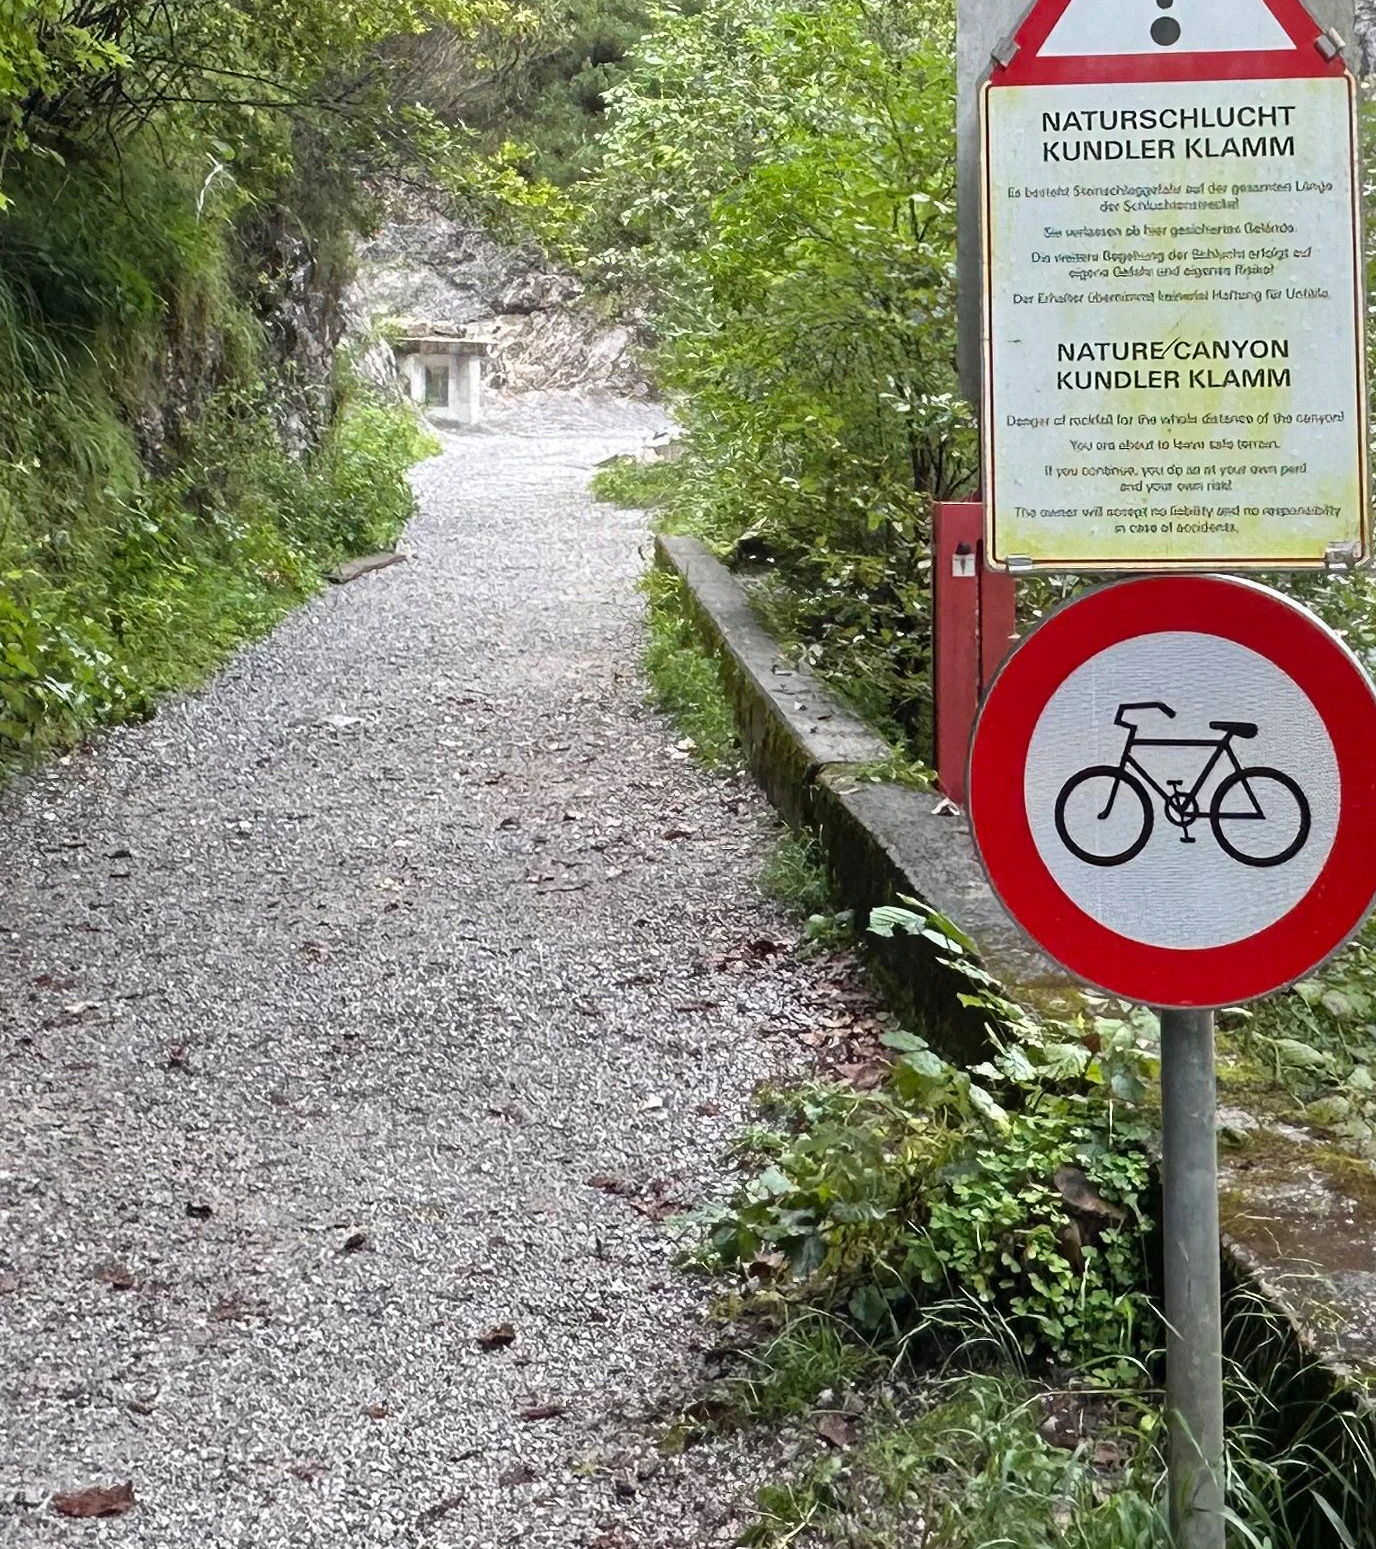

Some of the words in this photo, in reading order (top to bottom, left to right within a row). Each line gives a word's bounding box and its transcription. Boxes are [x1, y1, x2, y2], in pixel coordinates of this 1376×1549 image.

[1042, 106, 1296, 132] NATURSCHLUCHT
[1043, 140, 1175, 162] KUNDLER
[1185, 136, 1296, 160] KLAMM
[1208, 182, 1227, 195] der
[1232, 183, 1291, 196] gesamten
[1100, 201, 1120, 212] der
[1143, 225, 1167, 236] hier
[1168, 249, 1188, 261] der
[1013, 294, 1034, 304] Der
[1057, 341, 1164, 362] NATURE
[1174, 339, 1290, 361] CANYON
[1057, 370, 1180, 390] KUNDLER
[1189, 368, 1291, 389] KLAMM
[1007, 415, 1049, 428] Danger
[1117, 414, 1133, 426] for
[1138, 414, 1156, 425] the
[1161, 413, 1197, 425] whole
[1202, 413, 1253, 424] distance
[1257, 412, 1269, 424] of
[1273, 413, 1292, 424] the
[1069, 439, 1093, 451] You
[1119, 440, 1153, 450] about
[1158, 439, 1169, 449] to
[1056, 467, 1078, 478] you
[1142, 467, 1164, 477] you
[1220, 466, 1246, 477] your
[1250, 466, 1276, 475] own
[1120, 481, 1142, 492] and
[1146, 482, 1172, 493] your
[1177, 482, 1203, 492] own
[1014, 507, 1036, 518] The
[1082, 506, 1103, 517] will
[1151, 508, 1166, 516] no
[1216, 505, 1240, 516] and
[1244, 507, 1259, 516] no
[1161, 522, 1173, 533] of
